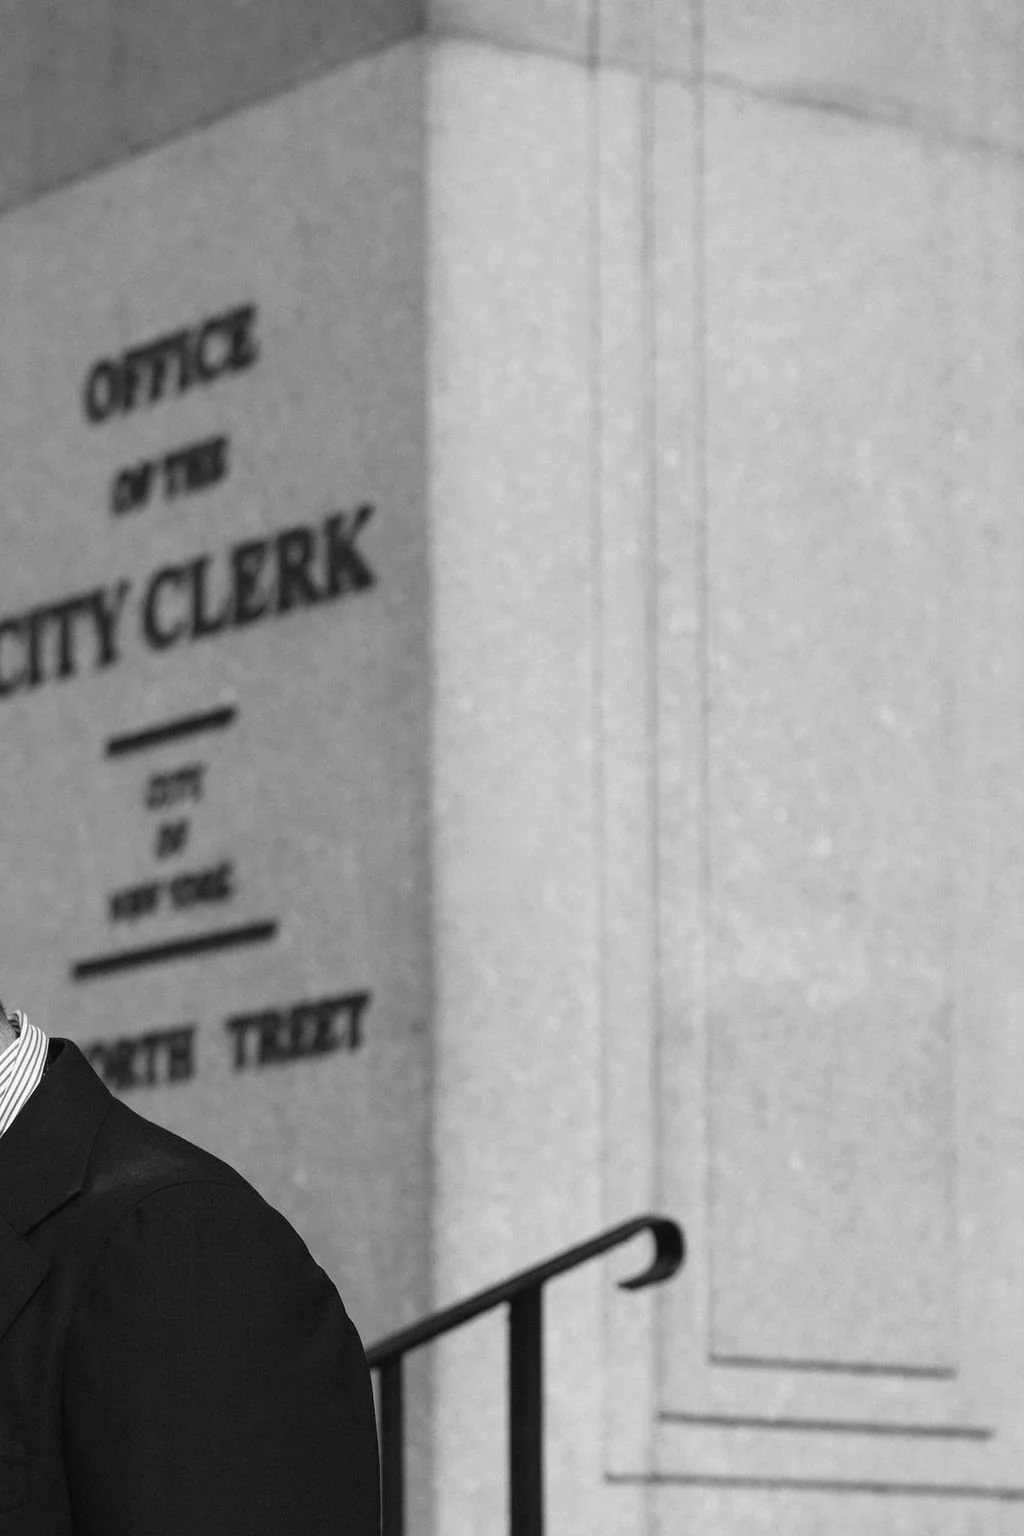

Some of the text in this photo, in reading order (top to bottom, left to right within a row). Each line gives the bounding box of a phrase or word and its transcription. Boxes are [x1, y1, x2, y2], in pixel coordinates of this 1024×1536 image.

[83, 303, 259, 425] OFFICE
[140, 503, 377, 652] CLERK
[86, 1023, 197, 1092] ORTH
